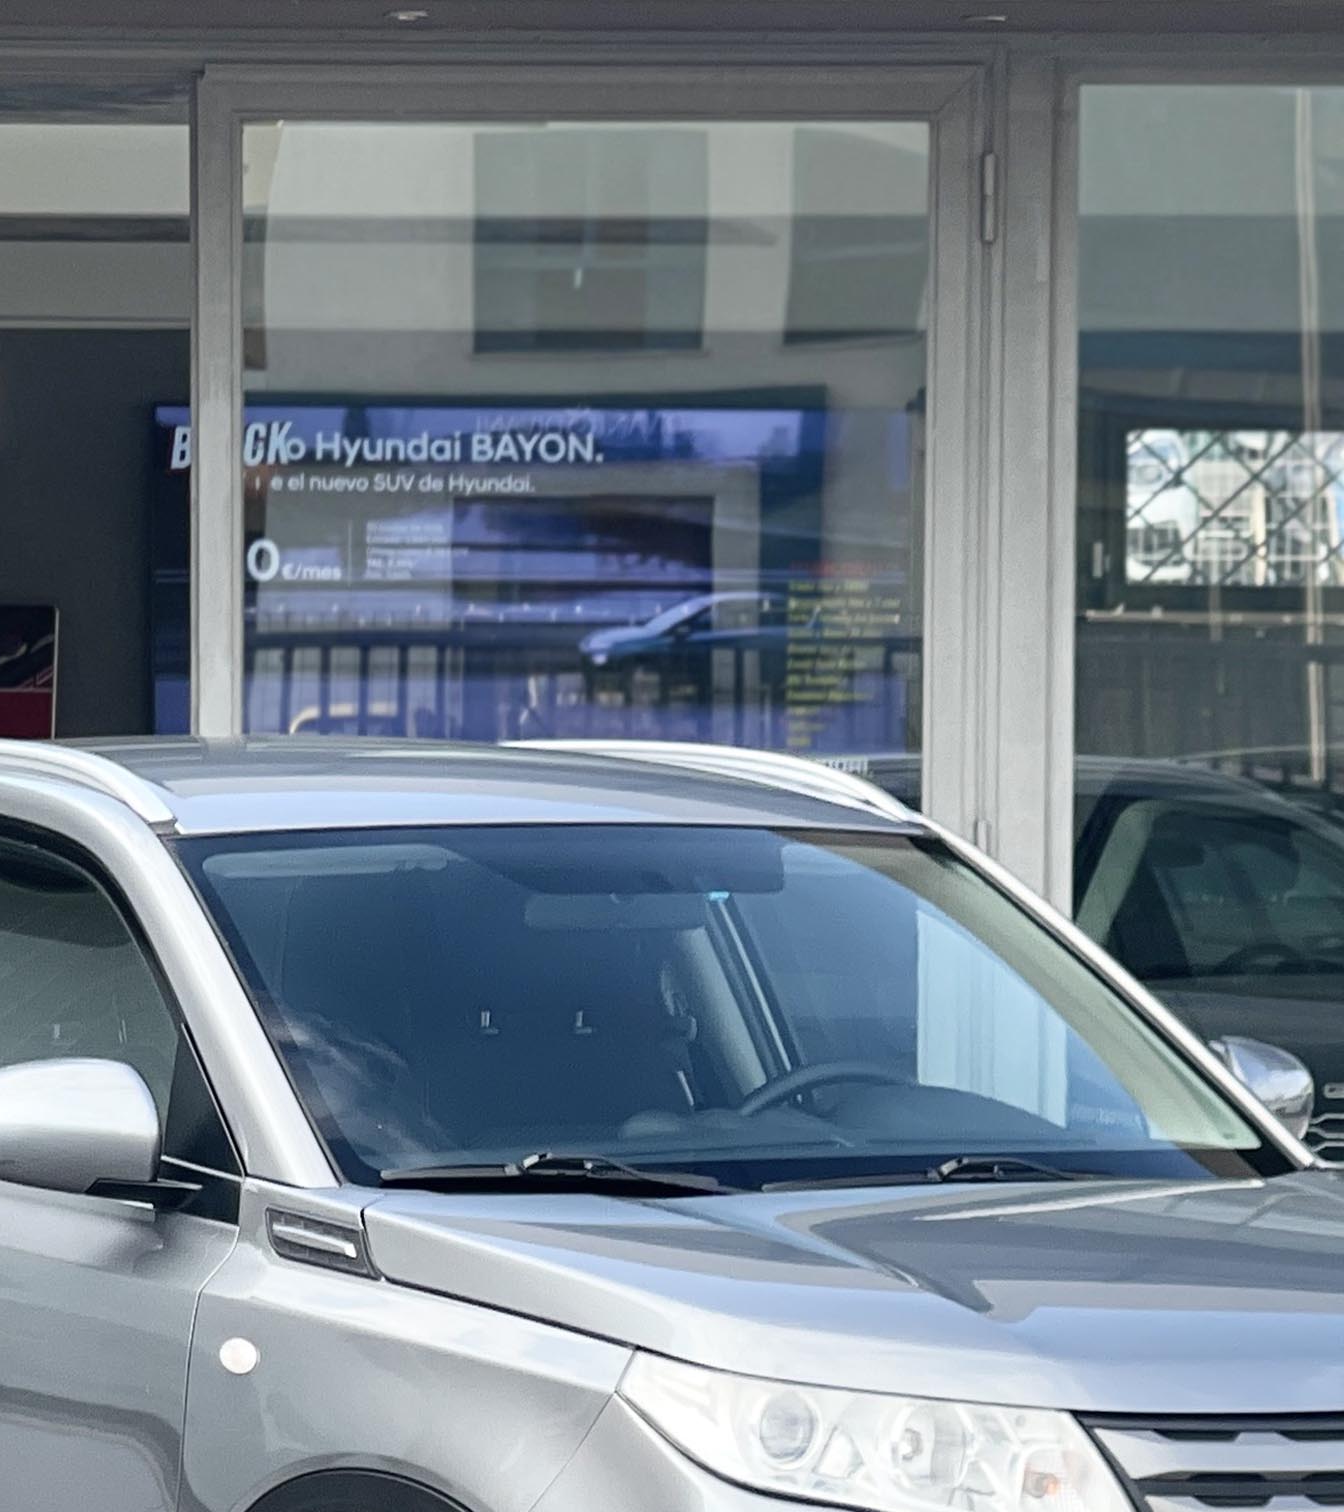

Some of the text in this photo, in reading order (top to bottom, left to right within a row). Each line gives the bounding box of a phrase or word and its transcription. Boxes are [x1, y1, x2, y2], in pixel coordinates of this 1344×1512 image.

[315, 431, 462, 467] Hyundai
[471, 433, 604, 464] BAYON.
[308, 477, 369, 493] nuevo
[373, 473, 415, 493] SUV
[418, 473, 444, 493] de
[448, 473, 536, 497] Hyundai.
